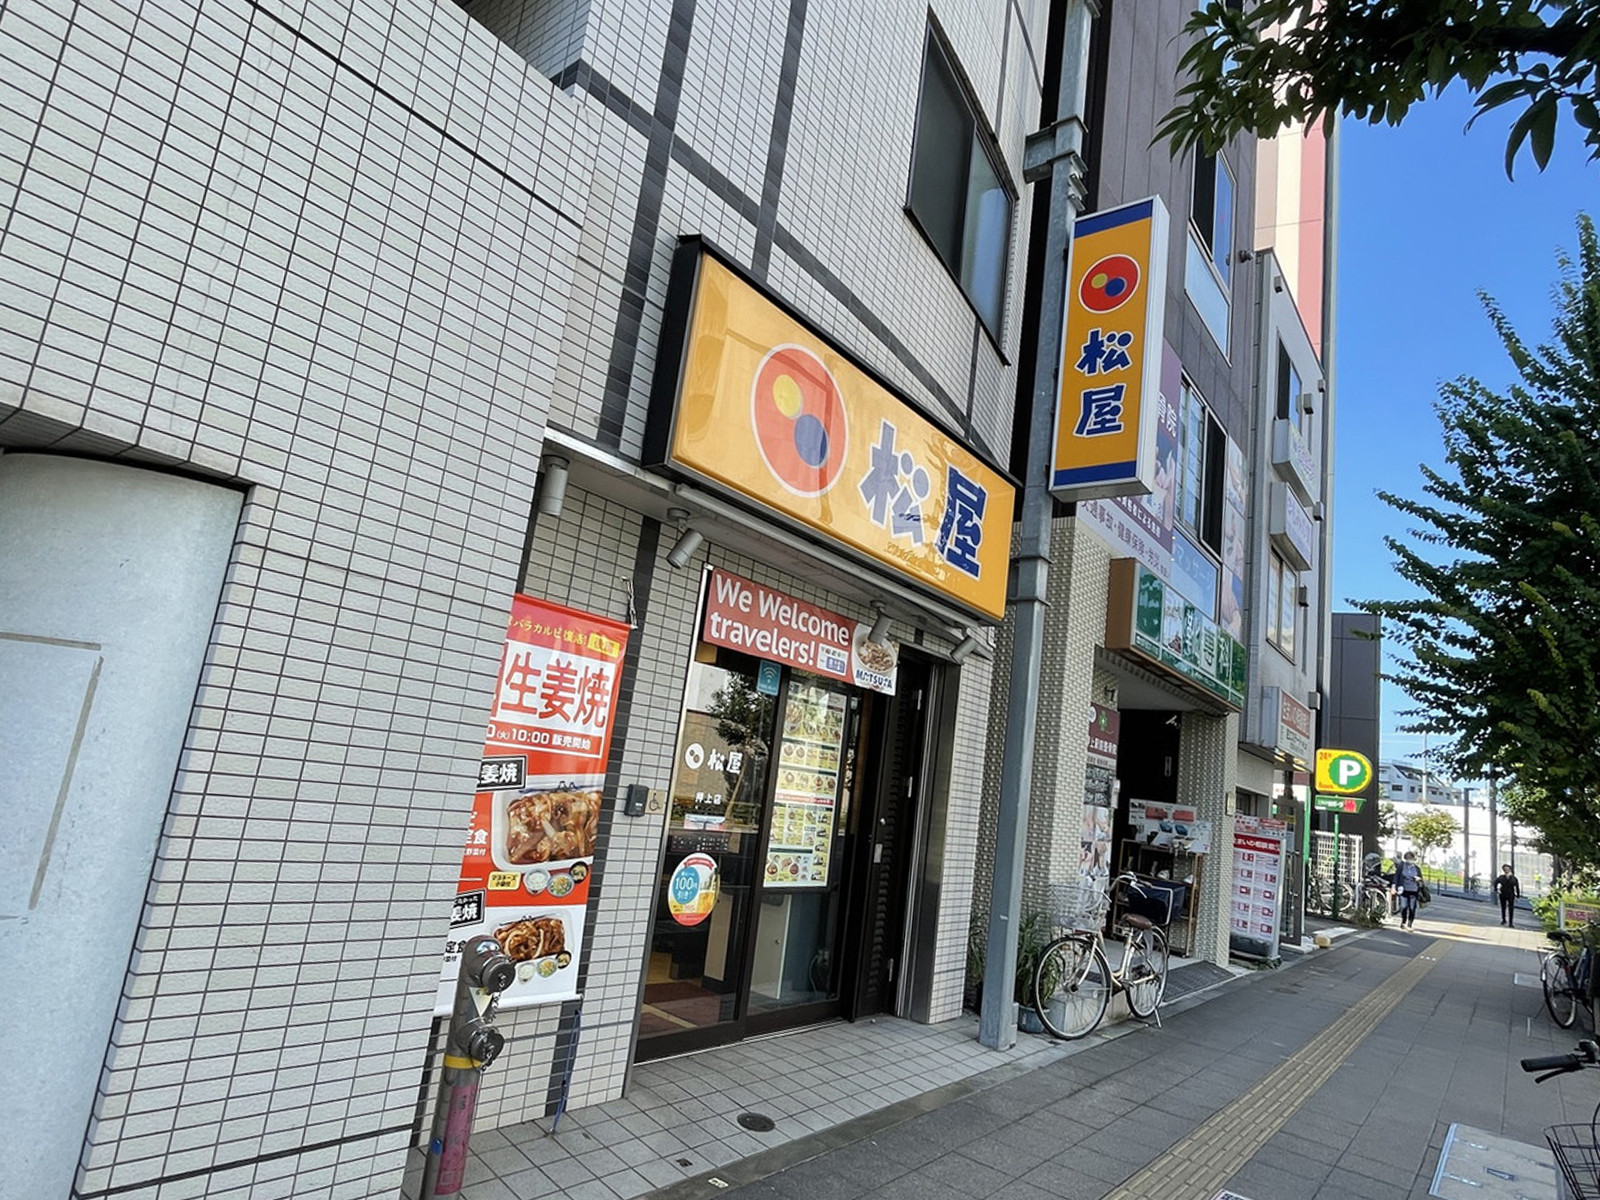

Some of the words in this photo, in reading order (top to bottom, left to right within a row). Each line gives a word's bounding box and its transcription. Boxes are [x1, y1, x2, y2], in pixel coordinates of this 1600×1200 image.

[1074, 328, 1134, 438] 松屋
[858, 418, 989, 582] 松屋
[715, 574, 752, 613] We
[759, 590, 849, 646] Welcome
[508, 615, 588, 645] バラカルビ復活!
[710, 611, 815, 666] travelers!
[500, 651, 610, 728] 生姜焼
[512, 728, 549, 745] 10:00
[552, 733, 591, 750] 販売開始
[477, 763, 518, 784] 姜焼
[707, 748, 743, 774] 松屋
[1339, 759, 1361, 785] P
[695, 792, 722, 805] 押上店
